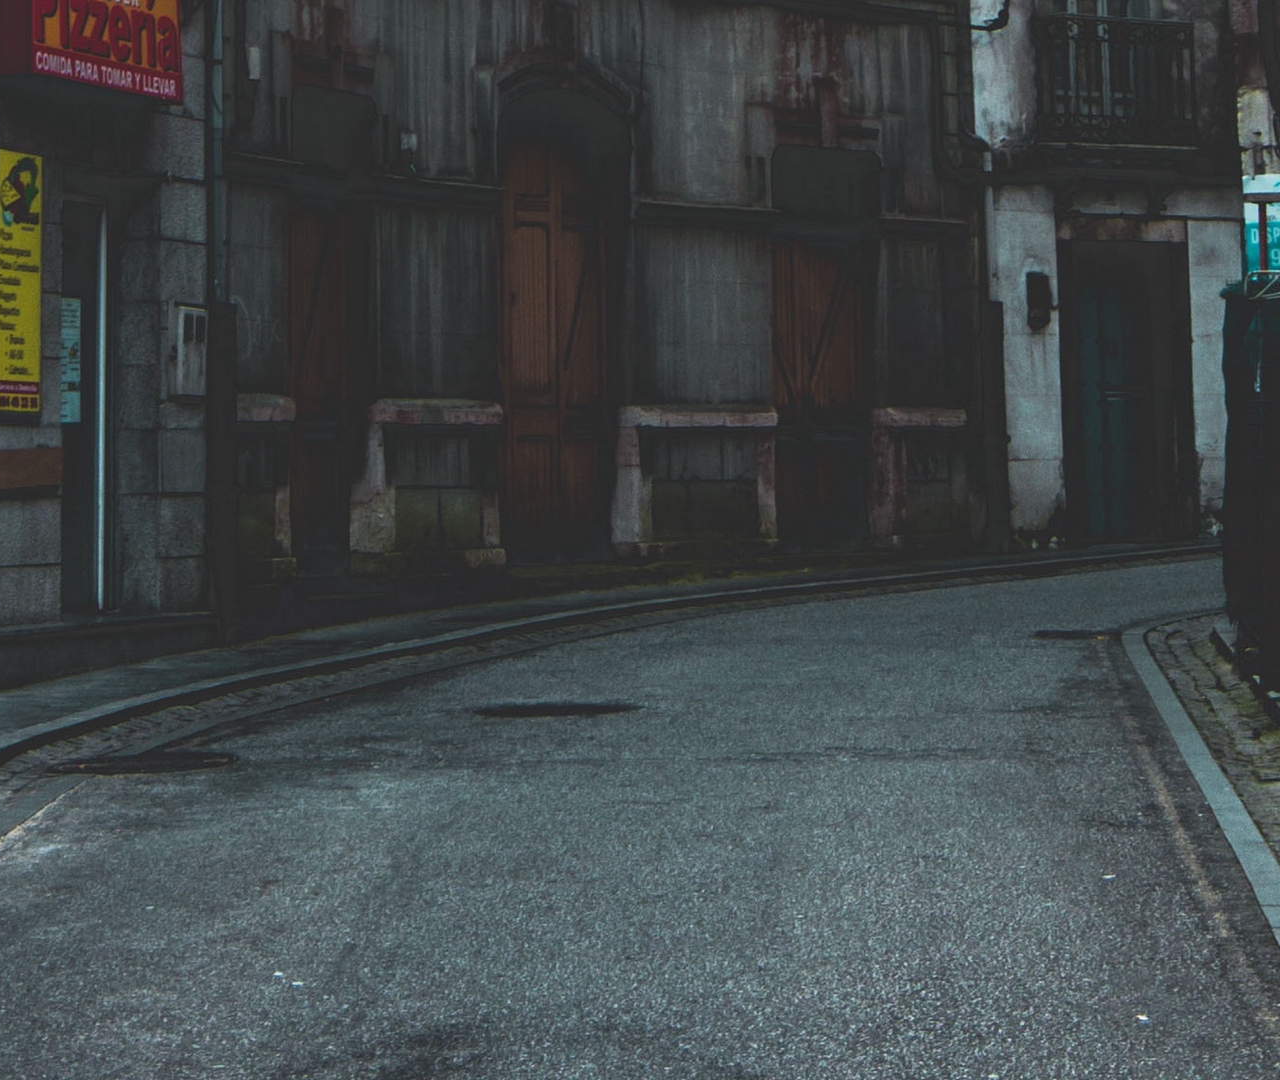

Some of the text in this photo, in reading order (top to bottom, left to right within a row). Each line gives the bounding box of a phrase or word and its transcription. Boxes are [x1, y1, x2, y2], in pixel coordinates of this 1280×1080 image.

[35, 51, 176, 96] COMIDA PARA TOMAR Y LLEVAR
